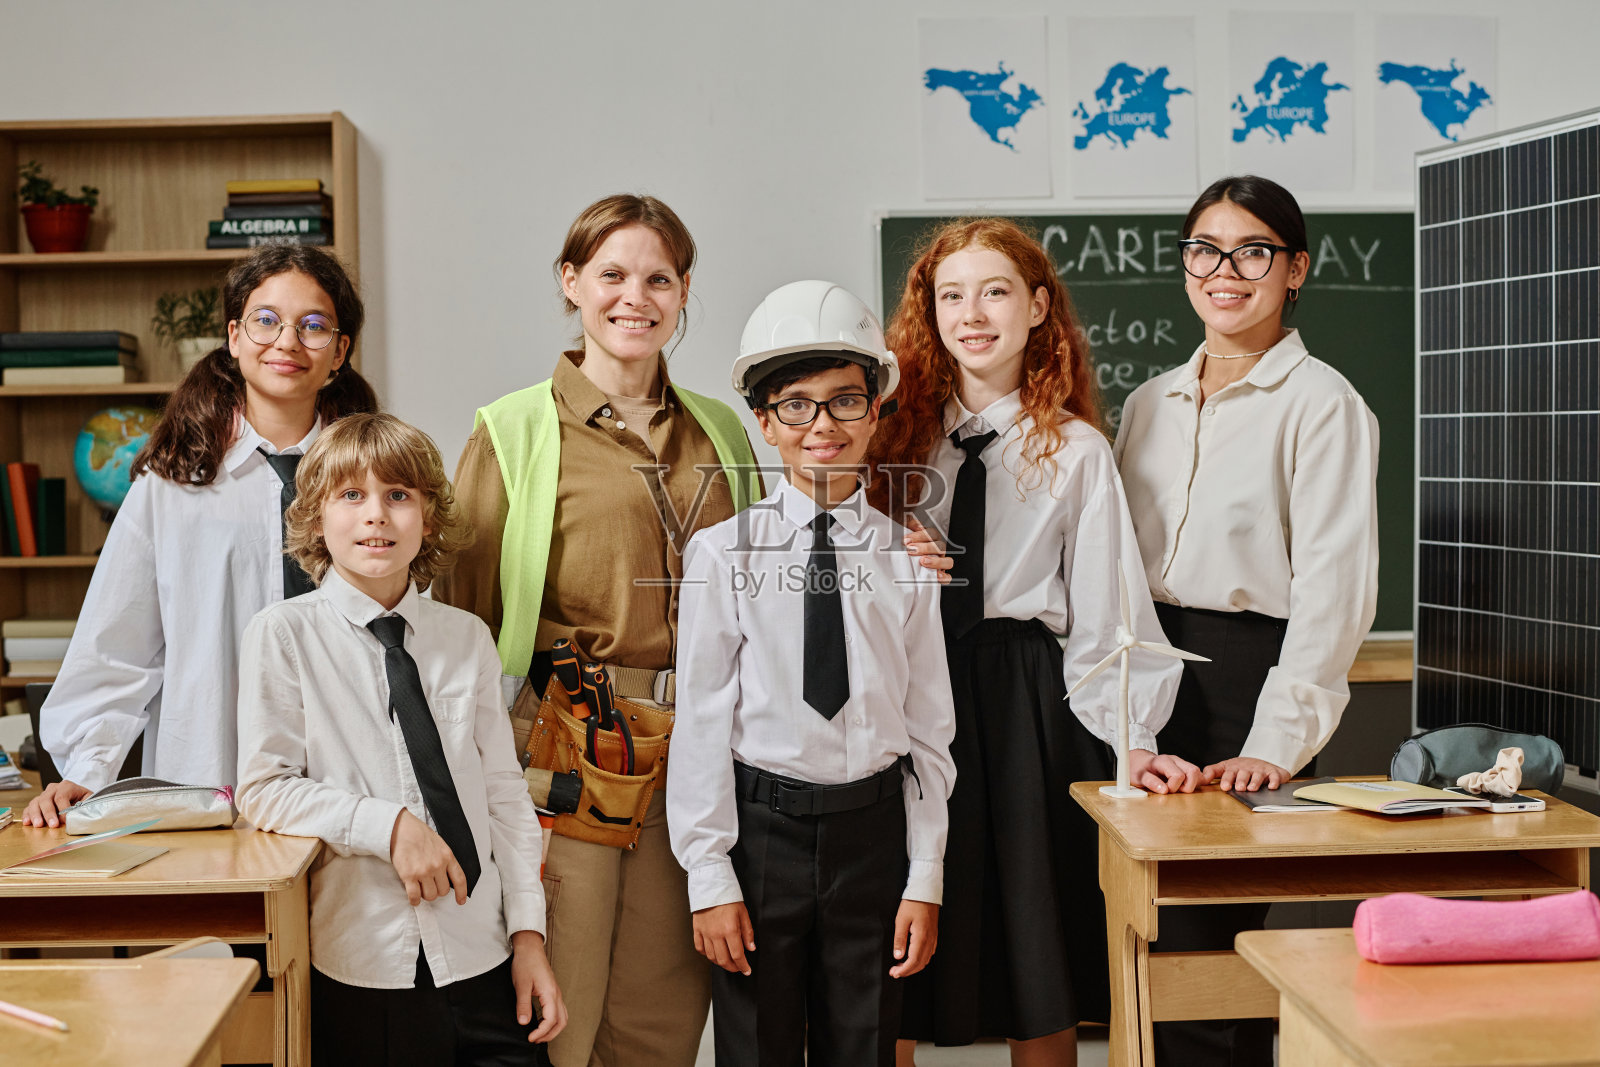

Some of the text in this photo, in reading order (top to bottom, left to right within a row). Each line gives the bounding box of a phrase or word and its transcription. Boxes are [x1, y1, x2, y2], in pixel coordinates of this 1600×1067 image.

[1107, 112, 1157, 126] EUROPE
[1266, 106, 1315, 121] EUROPE
[221, 219, 309, 234] ALGEBRA II
[1042, 225, 1381, 281] CARE AY
